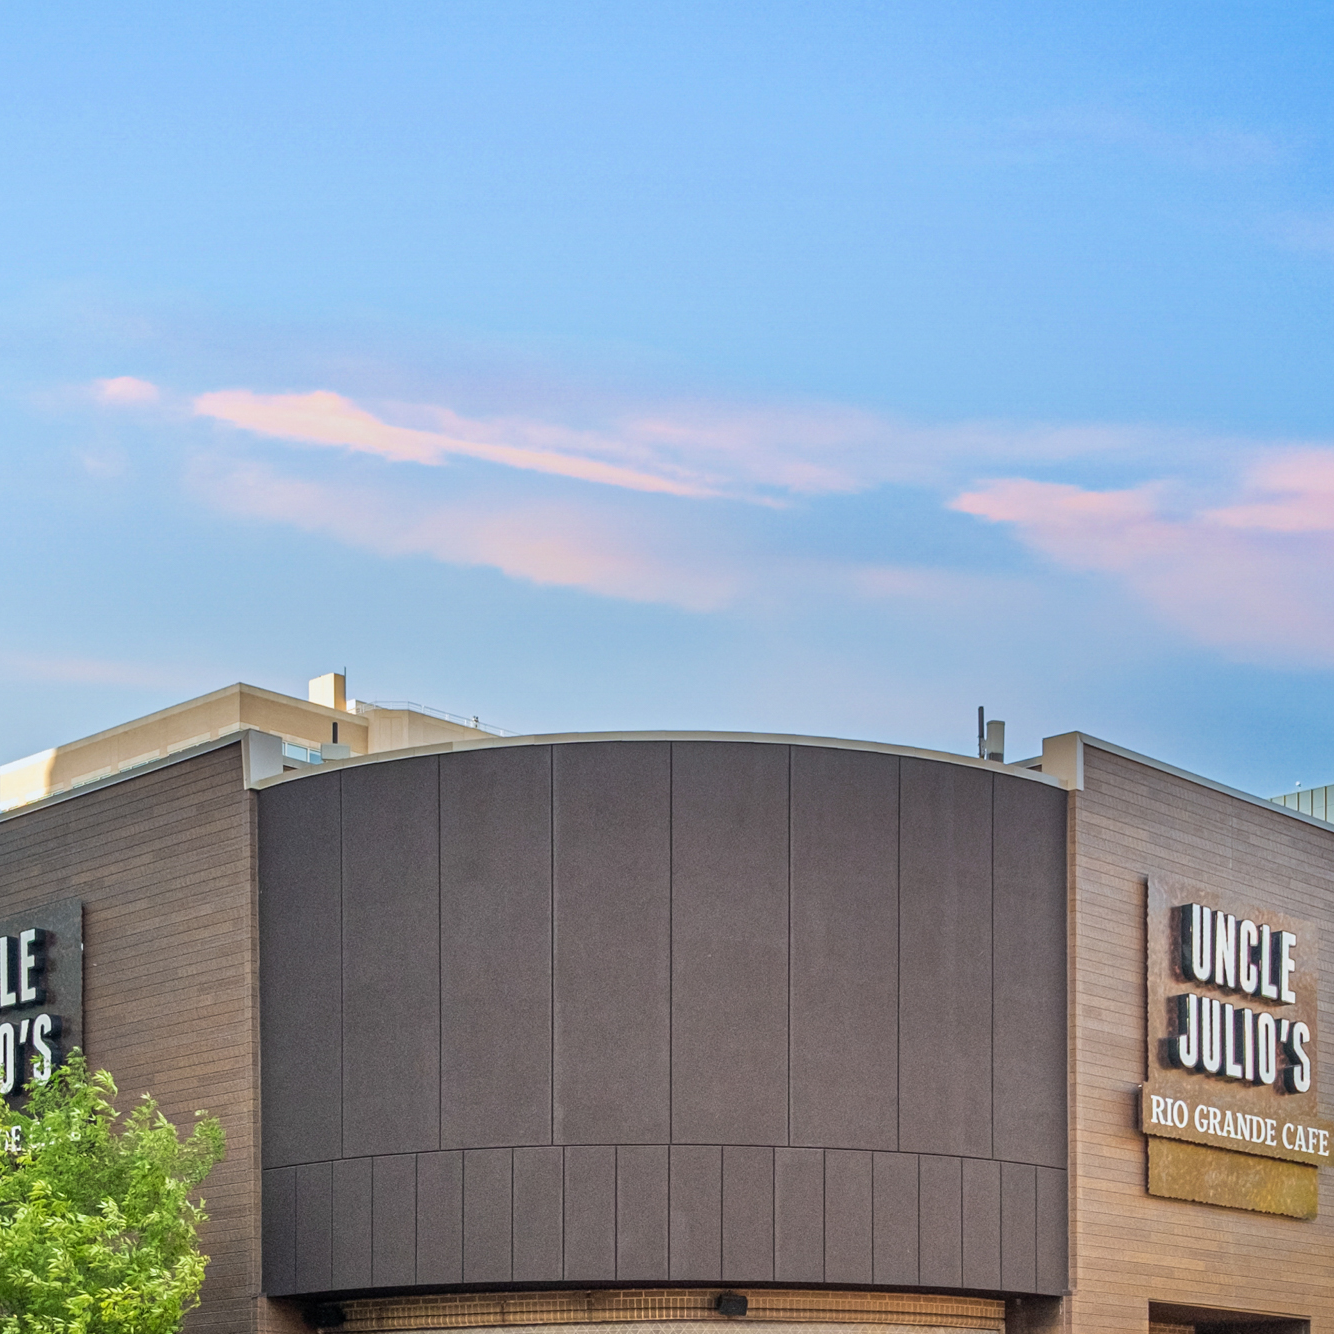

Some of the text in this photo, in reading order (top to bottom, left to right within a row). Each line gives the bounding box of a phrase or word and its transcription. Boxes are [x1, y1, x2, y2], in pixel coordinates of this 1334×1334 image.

[1191, 903, 1297, 1004] UNCLE
[1178, 993, 1311, 1093] JULIO'S
[1150, 1095, 1330, 1157] RIO GRANDE CAFE
